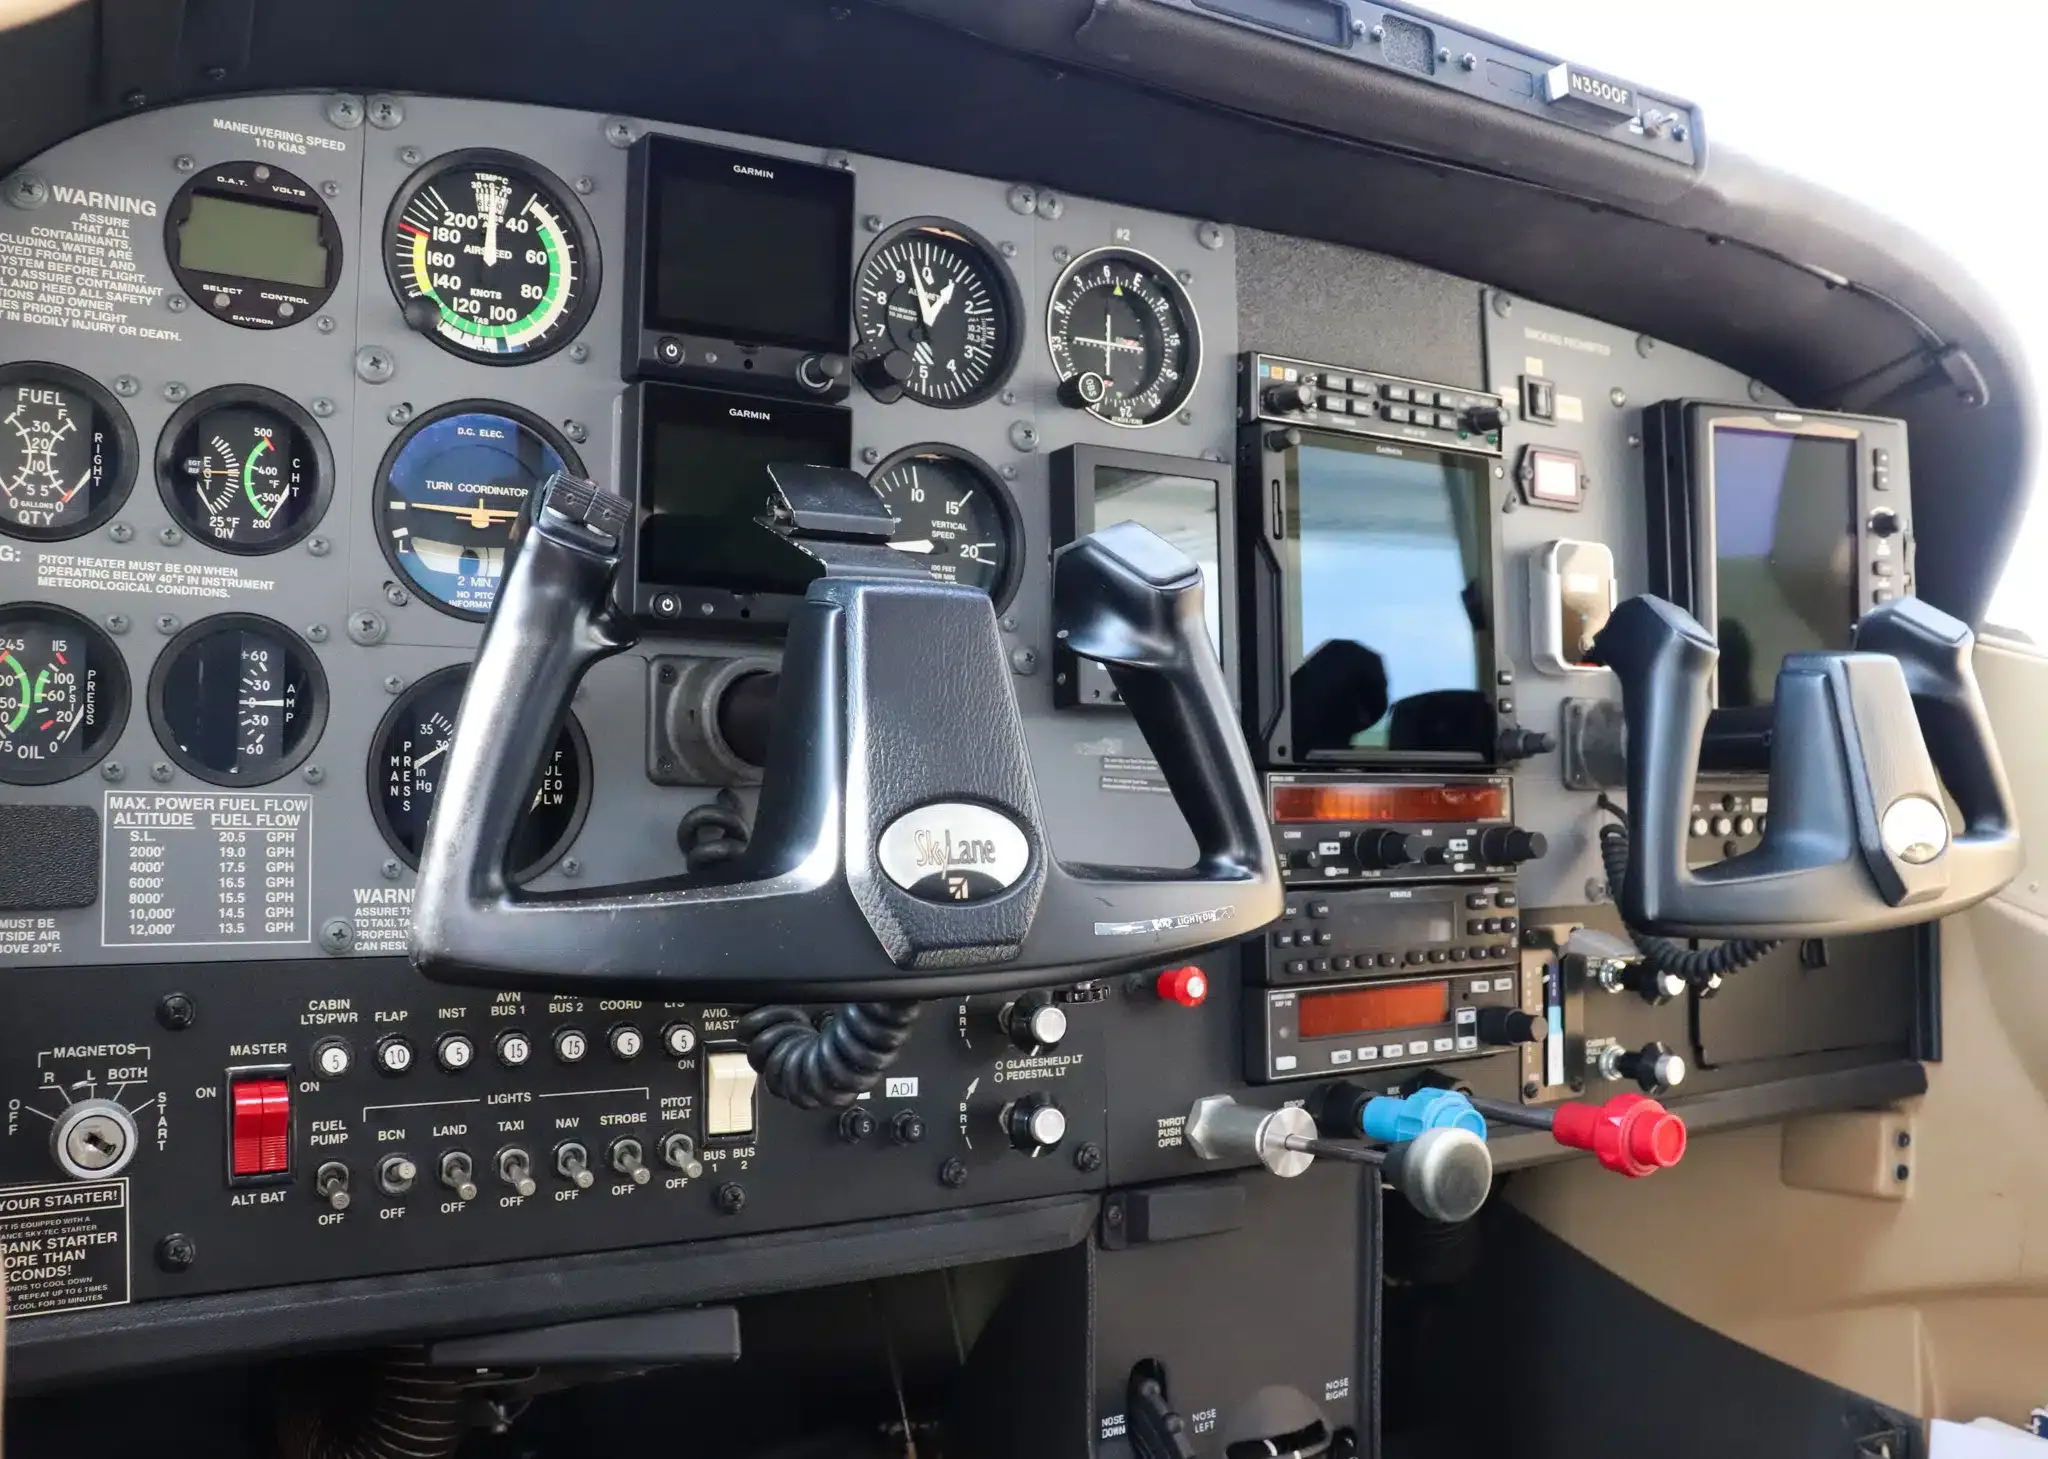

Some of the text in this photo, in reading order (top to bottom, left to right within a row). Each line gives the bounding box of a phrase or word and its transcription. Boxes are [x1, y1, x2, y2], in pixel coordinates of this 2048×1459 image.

[1572, 73, 1628, 104] N3500F
[213, 119, 345, 151] MANEUVERING SPEED
[255, 139, 306, 154] 110 KIAS
[733, 164, 774, 179] GARMIN
[217, 176, 306, 196] O.A.T. VOLTS
[53, 185, 156, 216] WARNING
[80, 213, 129, 228] ASSURE
[444, 212, 477, 229] 200
[506, 218, 528, 233] 40
[72, 222, 129, 239] THAT ALL
[433, 226, 460, 243] 180
[1116, 228, 1130, 241] #2
[32, 227, 131, 250] CONTAMINANTS,
[62, 243, 132, 260] WATER ARE
[526, 250, 546, 265] 60
[427, 251, 455, 268] 160
[48, 262, 146, 284] BEFORE FLIGHT.
[896, 270, 905, 283] 9
[76, 278, 163, 296] CONTAMINANT
[434, 273, 461, 290] 140
[202, 284, 243, 294] SELECT
[471, 288, 502, 299] KNOTS
[521, 284, 542, 299] 80
[106, 292, 152, 306] SAFETY
[261, 292, 309, 304] CONTROL
[453, 297, 480, 313] 120
[1157, 297, 1168, 312] 12
[490, 305, 517, 322] 100
[233, 315, 273, 325] DAVTRON
[140, 328, 182, 341] DEATH.
[19, 388, 65, 406] FUEL
[729, 408, 770, 421] GARMIN
[32, 421, 50, 433] 30
[254, 427, 272, 438] 500
[458, 428, 504, 438] D.C. ELEC.
[426, 480, 528, 497] TURN COORDINATOR
[911, 489, 924, 502] 10
[946, 501, 959, 515] 15
[19, 511, 54, 525] QTY
[252, 519, 270, 529] 200
[932, 520, 967, 530] VERTICAL
[215, 528, 234, 538] DIV
[932, 531, 955, 539] SPEED
[960, 545, 979, 558] 20
[39, 554, 238, 577] PITOT HEATER MUST BE ON WHEN
[38, 566, 109, 580] OPERATING
[113, 570, 155, 583] BELOW
[187, 575, 199, 584] IN
[201, 576, 274, 590] INSTRUMENT
[472, 578, 493, 588] MIN.
[38, 577, 230, 598] METEOROLOGICAL CONDITIONS.
[52, 640, 66, 651] 115
[253, 680, 270, 691] 30
[420, 724, 433, 734] 35
[18, 747, 44, 759] OIL
[416, 780, 432, 792] Hg
[110, 797, 308, 812] MAX. POWER FUEL FLOW
[114, 812, 300, 826] ALTITUDE FUEL FLOW
[130, 831, 295, 842] S.L. 20.5 GPH
[220, 848, 246, 858] 19.0
[38, 919, 54, 928] BE
[218, 923, 244, 934] 13.5
[40, 931, 60, 941] AIR
[496, 992, 521, 1002] AVN
[309, 999, 350, 1011] CABIN
[491, 1005, 525, 1016] BUS 1
[550, 1003, 583, 1013] BUS 2
[600, 1000, 642, 1010] COORD
[301, 1012, 358, 1025] LTS/PWR
[375, 1011, 408, 1022] FLAP
[439, 1008, 466, 1019] INST
[703, 1008, 730, 1018] AVIO.
[54, 1044, 136, 1058] MAGNETOS
[230, 1043, 287, 1056] MASTER
[511, 1043, 523, 1058] 15
[390, 1049, 405, 1065] 10
[1006, 1055, 1083, 1070] GLARESHIELD LT
[108, 1068, 148, 1080] BOTH
[1006, 1067, 1066, 1080] PEDESTAL LT
[196, 1088, 216, 1098] ON
[891, 1083, 913, 1095] ADI
[487, 1092, 532, 1105] LIGHTS
[661, 1097, 692, 1108] PITOT
[600, 1113, 647, 1125] STROBE
[662, 1110, 691, 1120] HEAT
[312, 1120, 346, 1132] FUEL
[498, 1120, 524, 1131] TAXI
[556, 1118, 579, 1128] NAV
[1158, 1117, 1186, 1126] THROT
[378, 1129, 405, 1141] BCN
[433, 1125, 467, 1136] LAND
[1158, 1127, 1182, 1137] PUSH
[311, 1133, 348, 1146] PUMP
[1158, 1137, 1182, 1148] OPEN
[612, 1185, 635, 1195] OFF
[45, 1190, 117, 1207] STARTER!
[232, 1191, 286, 1206] ALT BAT
[380, 1208, 405, 1219] OFF
[441, 1202, 466, 1213] OFF
[21, 1219, 61, 1229] EQUIPPED
[25, 1229, 59, 1237] SKY-TEC
[47, 1232, 117, 1249] STARTER
[43, 1249, 85, 1264] THAN
[68, 1294, 102, 1304] MINUTES
[1326, 1378, 1348, 1390] NOSE
[1326, 1388, 1348, 1400] RIGHT
[1102, 1415, 1124, 1427] NOSE
[1192, 1409, 1216, 1422] NOSE
[1102, 1426, 1126, 1438] DOWN
[1195, 1421, 1214, 1433] LEFT
